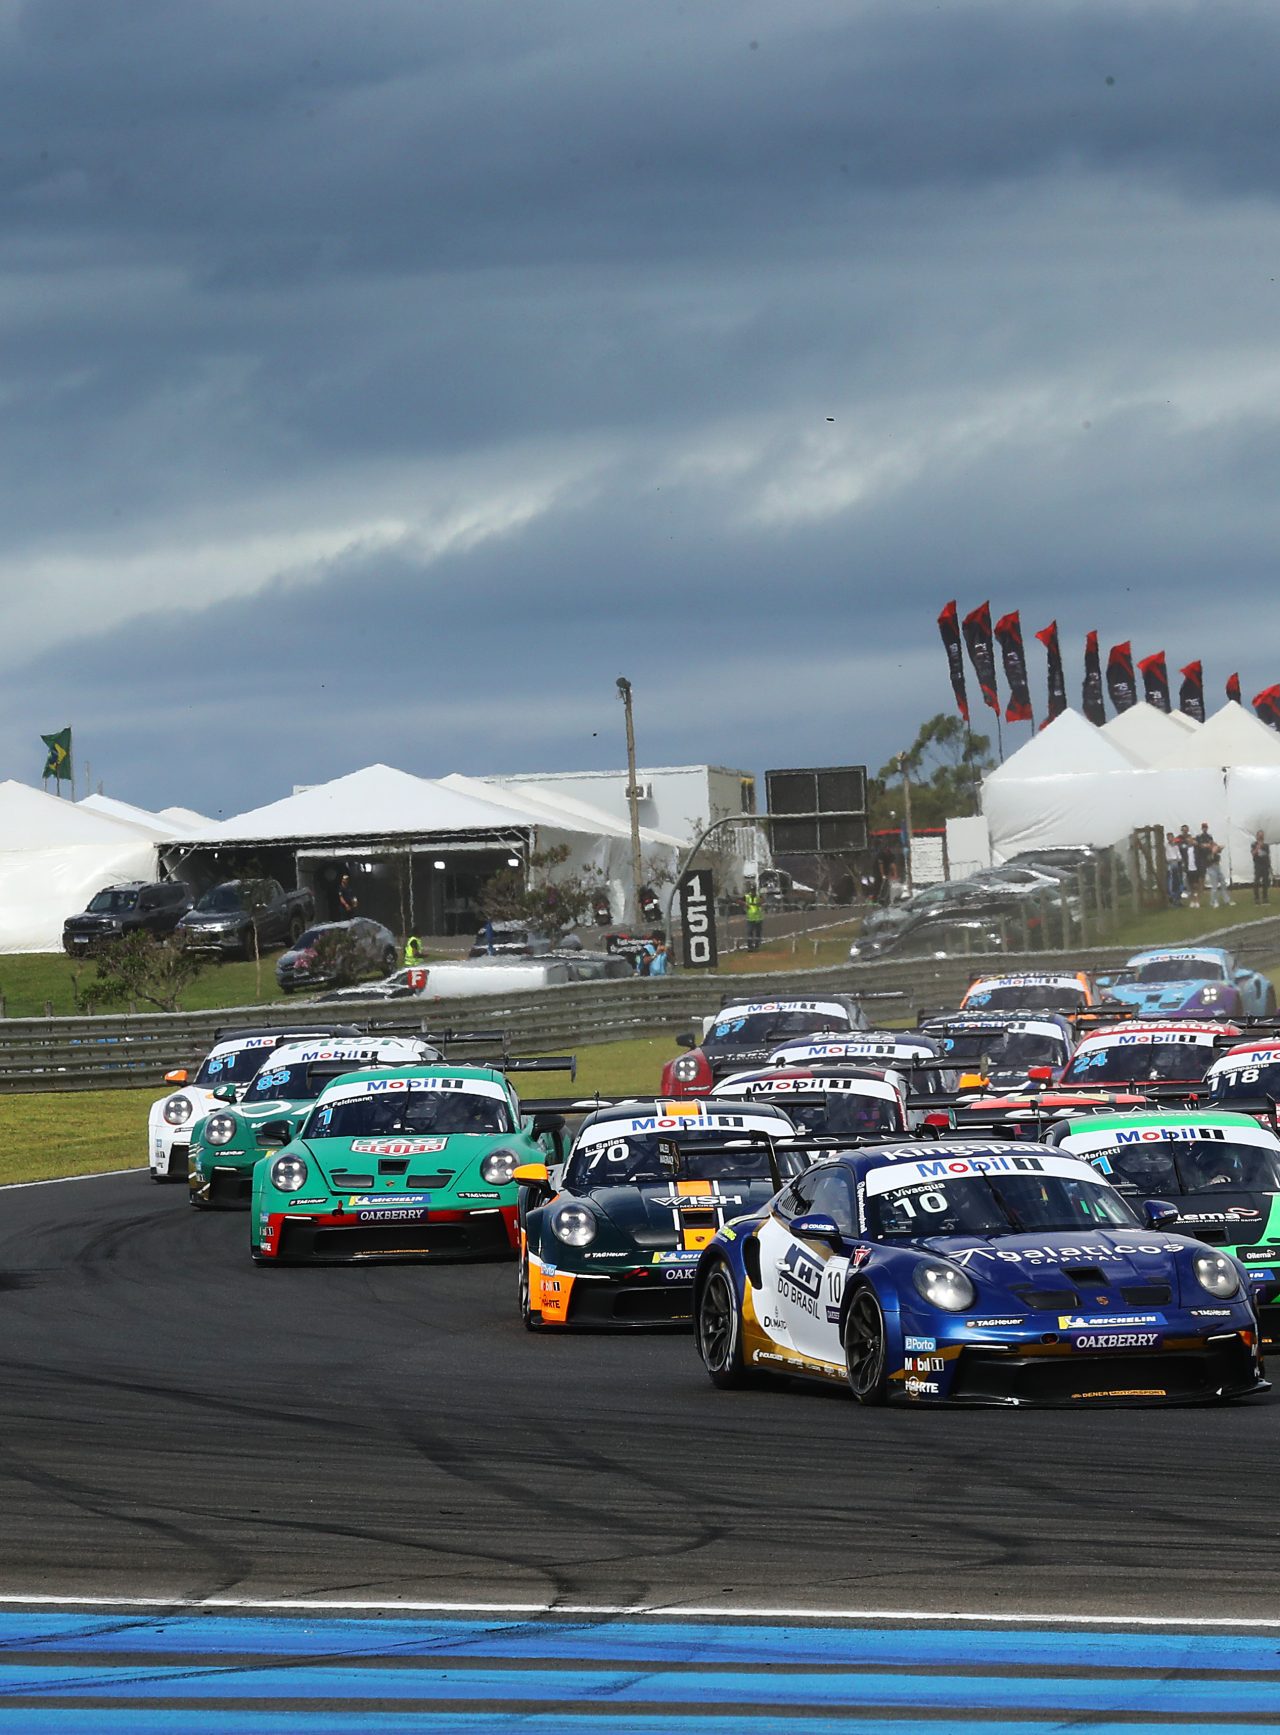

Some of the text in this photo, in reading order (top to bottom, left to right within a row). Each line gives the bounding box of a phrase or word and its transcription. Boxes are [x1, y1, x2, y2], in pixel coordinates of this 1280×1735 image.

[686, 875, 712, 963] 150
[410, 971, 424, 987] F
[999, 977, 1043, 987] Mobil
[748, 1002, 798, 1012] Mobil
[1118, 1034, 1176, 1044] Mobil
[301, 1050, 358, 1061] Mobil
[808, 1045, 871, 1055] Mobil
[207, 1055, 236, 1075] 51
[1073, 1052, 1108, 1073] 24
[256, 1070, 291, 1091] 83
[367, 1078, 437, 1092] Mobil
[752, 1078, 824, 1093] Mobil
[1207, 1069, 1260, 1092] 118
[332, 1095, 373, 1107] Feldmann
[318, 1107, 334, 1126] 1
[631, 1115, 713, 1132] Mobil
[595, 1137, 626, 1151] Salles
[1115, 1128, 1197, 1144] Mobil
[584, 1143, 630, 1170] 70
[882, 1143, 1058, 1162] Kingspan
[915, 1157, 1009, 1178] Mobil
[1090, 1155, 1114, 1175] 1
[881, 1181, 946, 1201] T. Vivacqua
[650, 1195, 743, 1206] WISH
[893, 1192, 949, 1219] 10
[361, 1209, 425, 1221] OAKBERRY
[996, 1242, 1185, 1264] galaticos
[1030, 1254, 1123, 1266] CAPITAL
[827, 1270, 841, 1304] 10
[777, 1278, 821, 1321] DO BRASIL
[976, 1318, 1023, 1328] TAGHeuer
[1089, 1314, 1157, 1325] MICHELIN
[911, 1337, 935, 1350] Porto
[1075, 1333, 1159, 1350] OAKBERRY
[904, 1357, 931, 1372] Mobil
